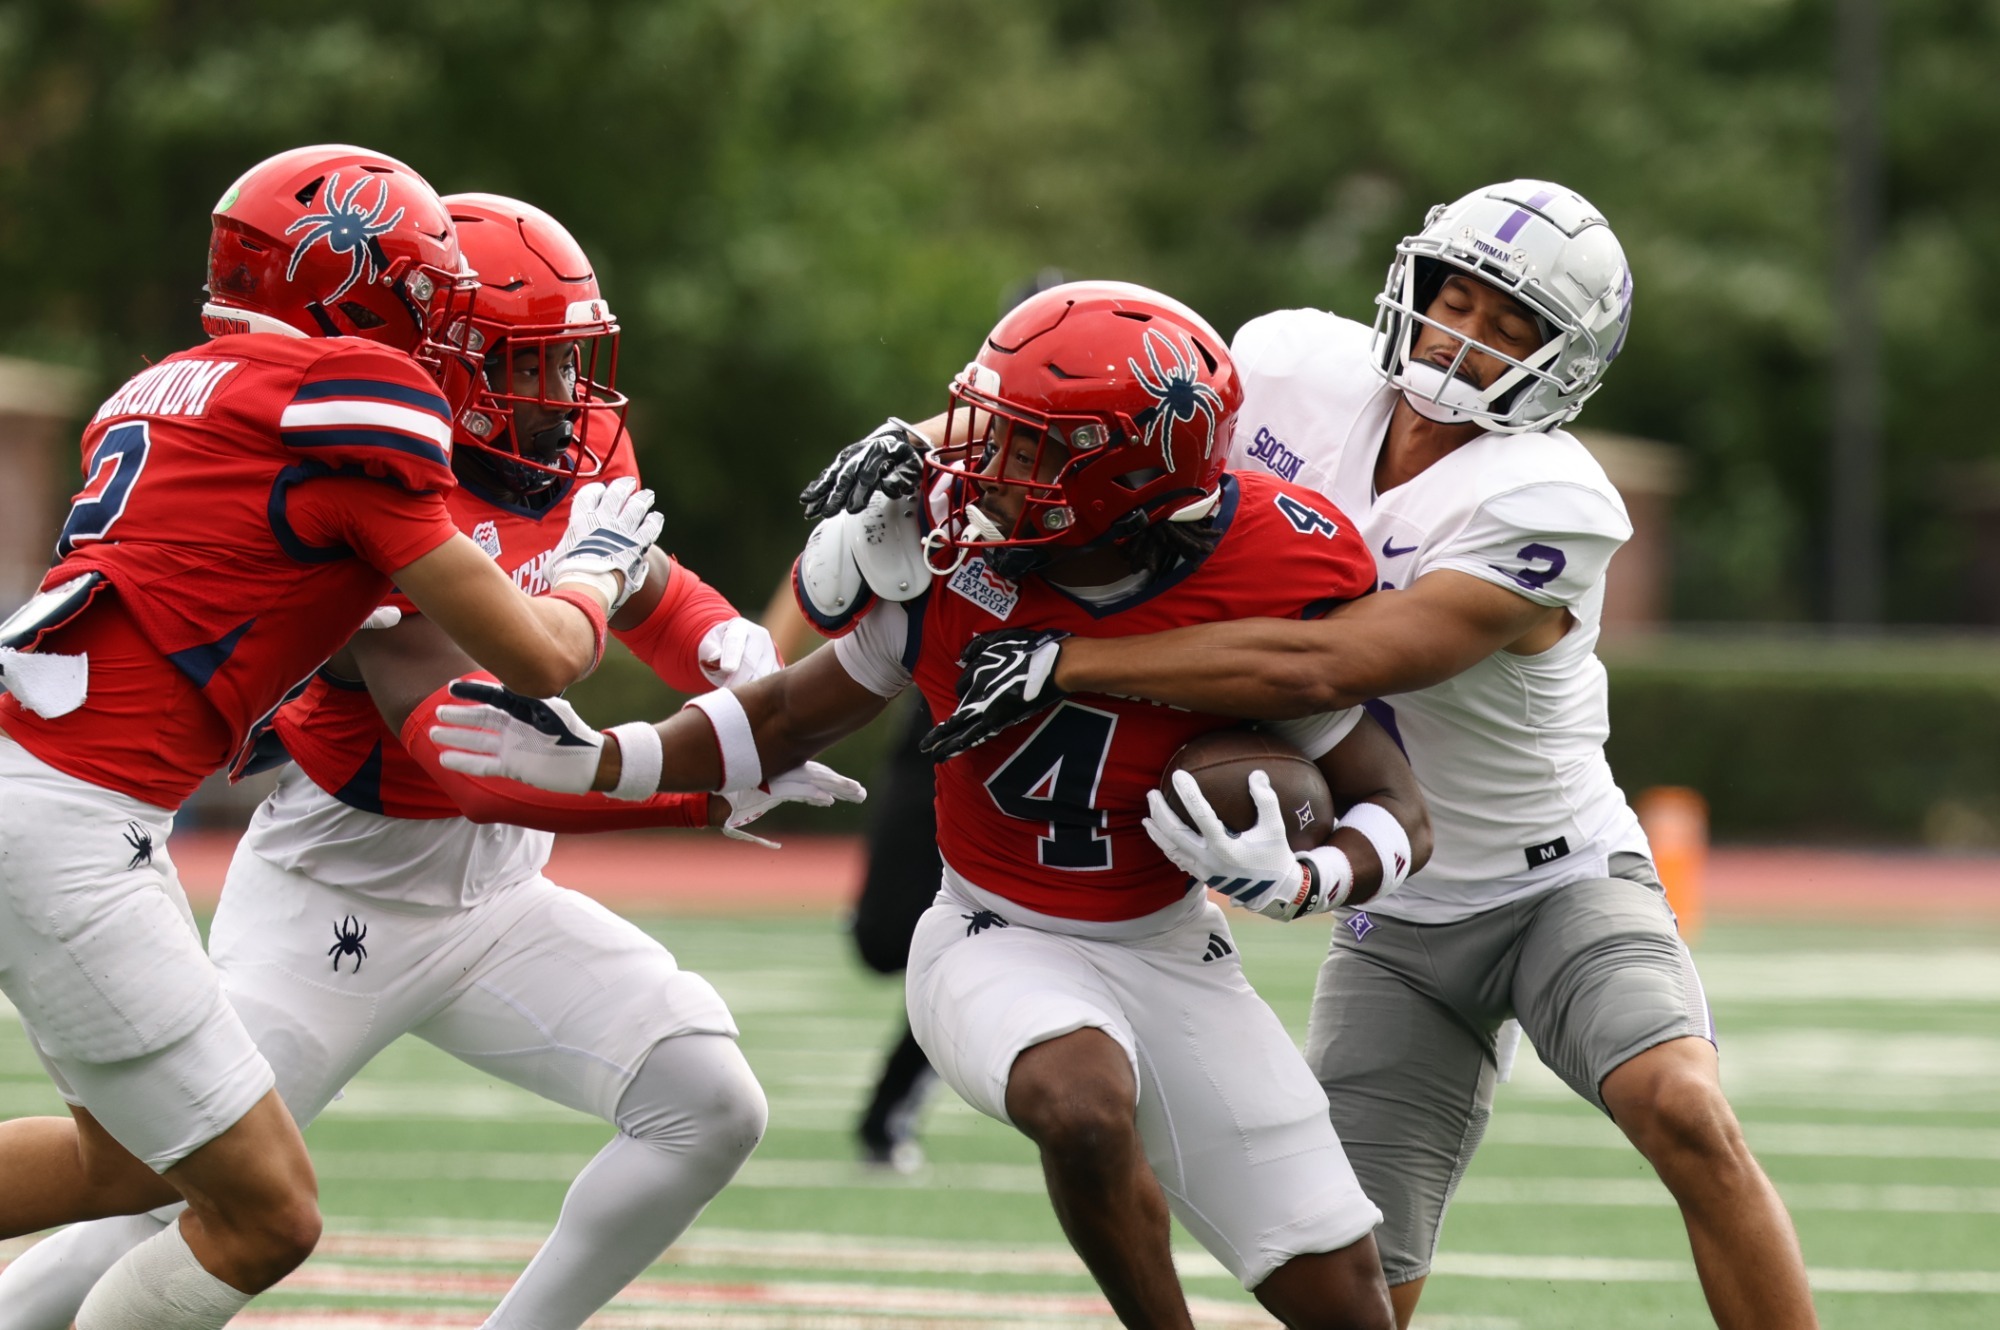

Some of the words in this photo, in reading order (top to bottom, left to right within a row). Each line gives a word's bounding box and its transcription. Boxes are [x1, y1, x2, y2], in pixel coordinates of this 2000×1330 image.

[1473, 239, 1511, 262] FURMAN
[1247, 426, 1305, 483] SOCON
[1273, 491, 1339, 540] 4
[951, 579, 1008, 616] LEAGUE
[956, 571, 1012, 608] PATRIOT
[983, 699, 1119, 872] 4
[1539, 845, 1557, 860] M
